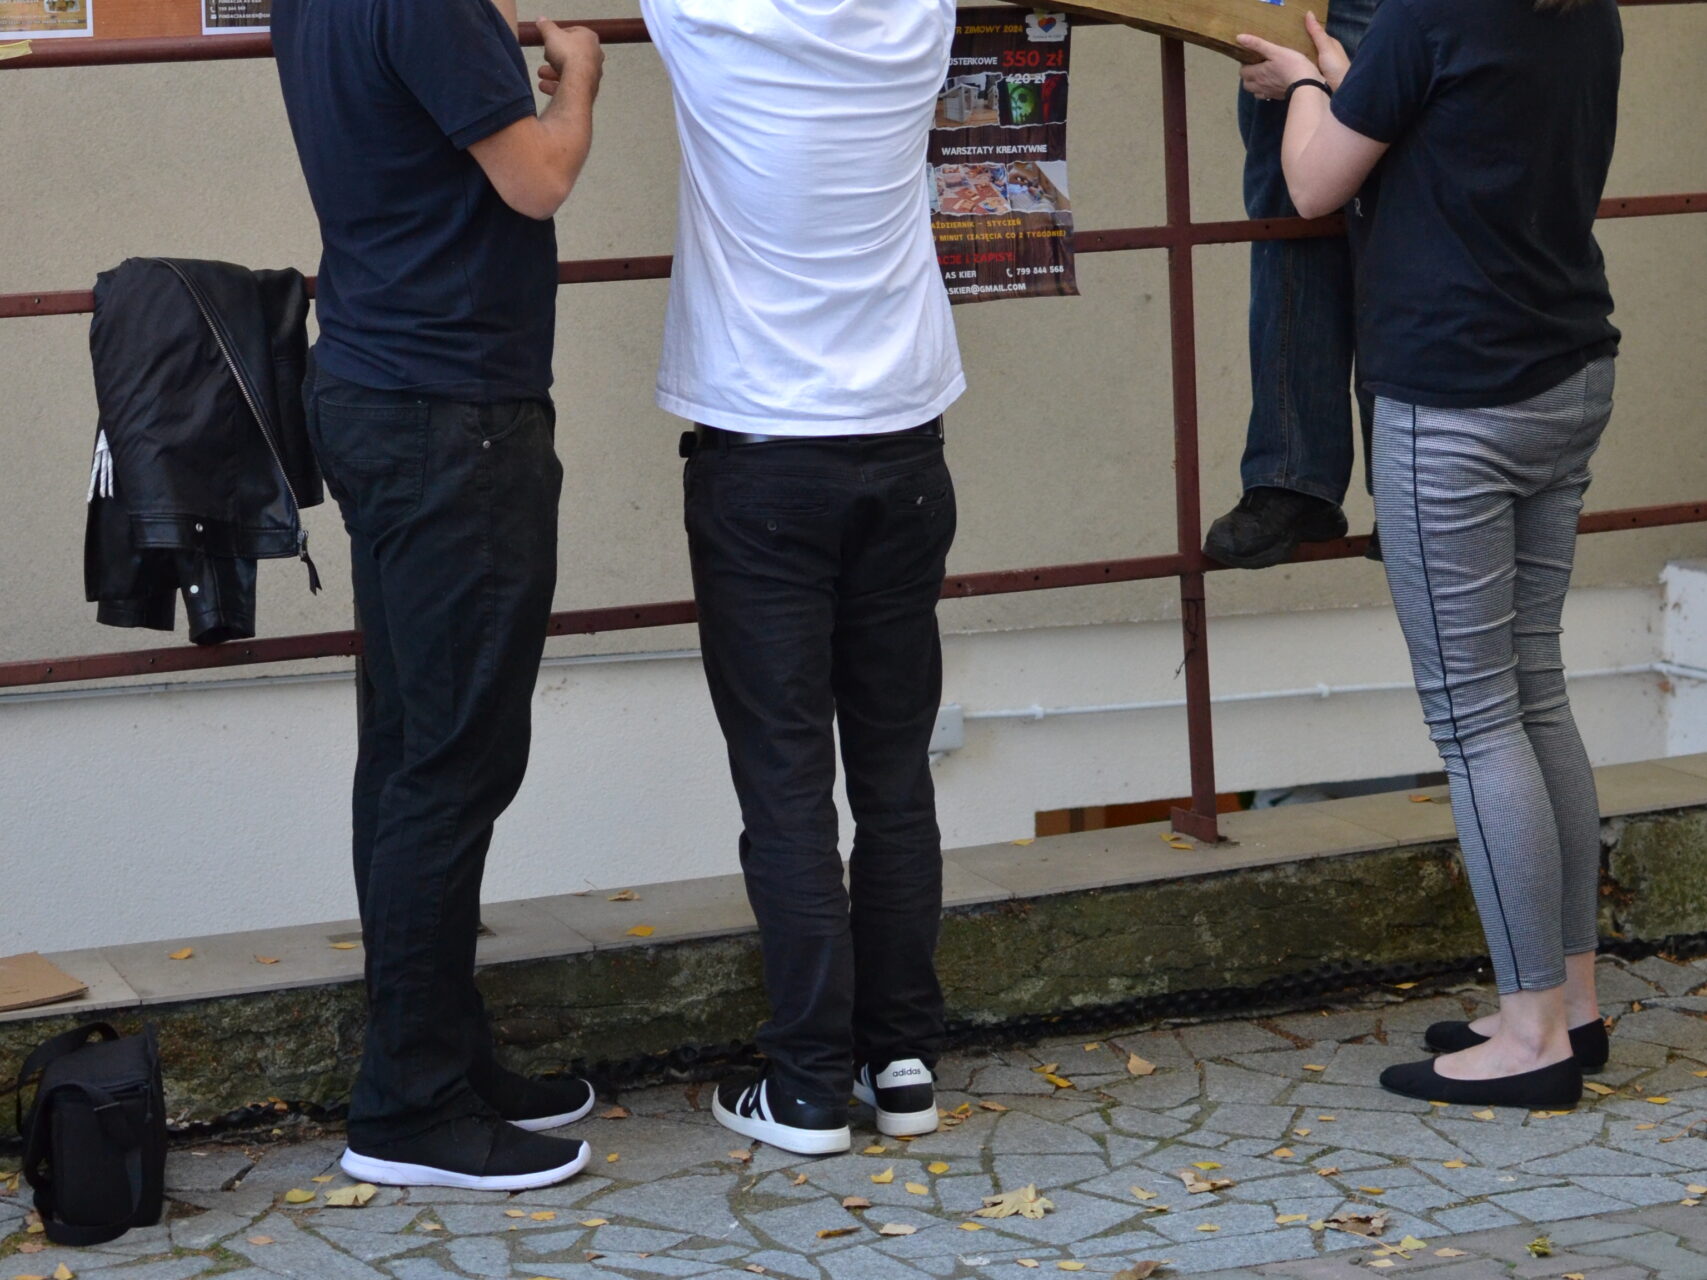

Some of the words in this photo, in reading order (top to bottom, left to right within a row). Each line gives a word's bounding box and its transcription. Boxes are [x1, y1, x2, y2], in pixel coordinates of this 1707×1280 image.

[964, 25, 1001, 34] ZIMOWY
[1002, 49, 1040, 67] 350
[1045, 48, 1064, 66] zł
[1006, 73, 1031, 84] 420
[942, 145, 994, 156] WARSZTATY
[996, 144, 1048, 154] KREATYWNE
[945, 271, 957, 279] AS
[959, 270, 977, 278] KIER
[1016, 267, 1031, 275] 799
[891, 1067, 922, 1078] adidas
